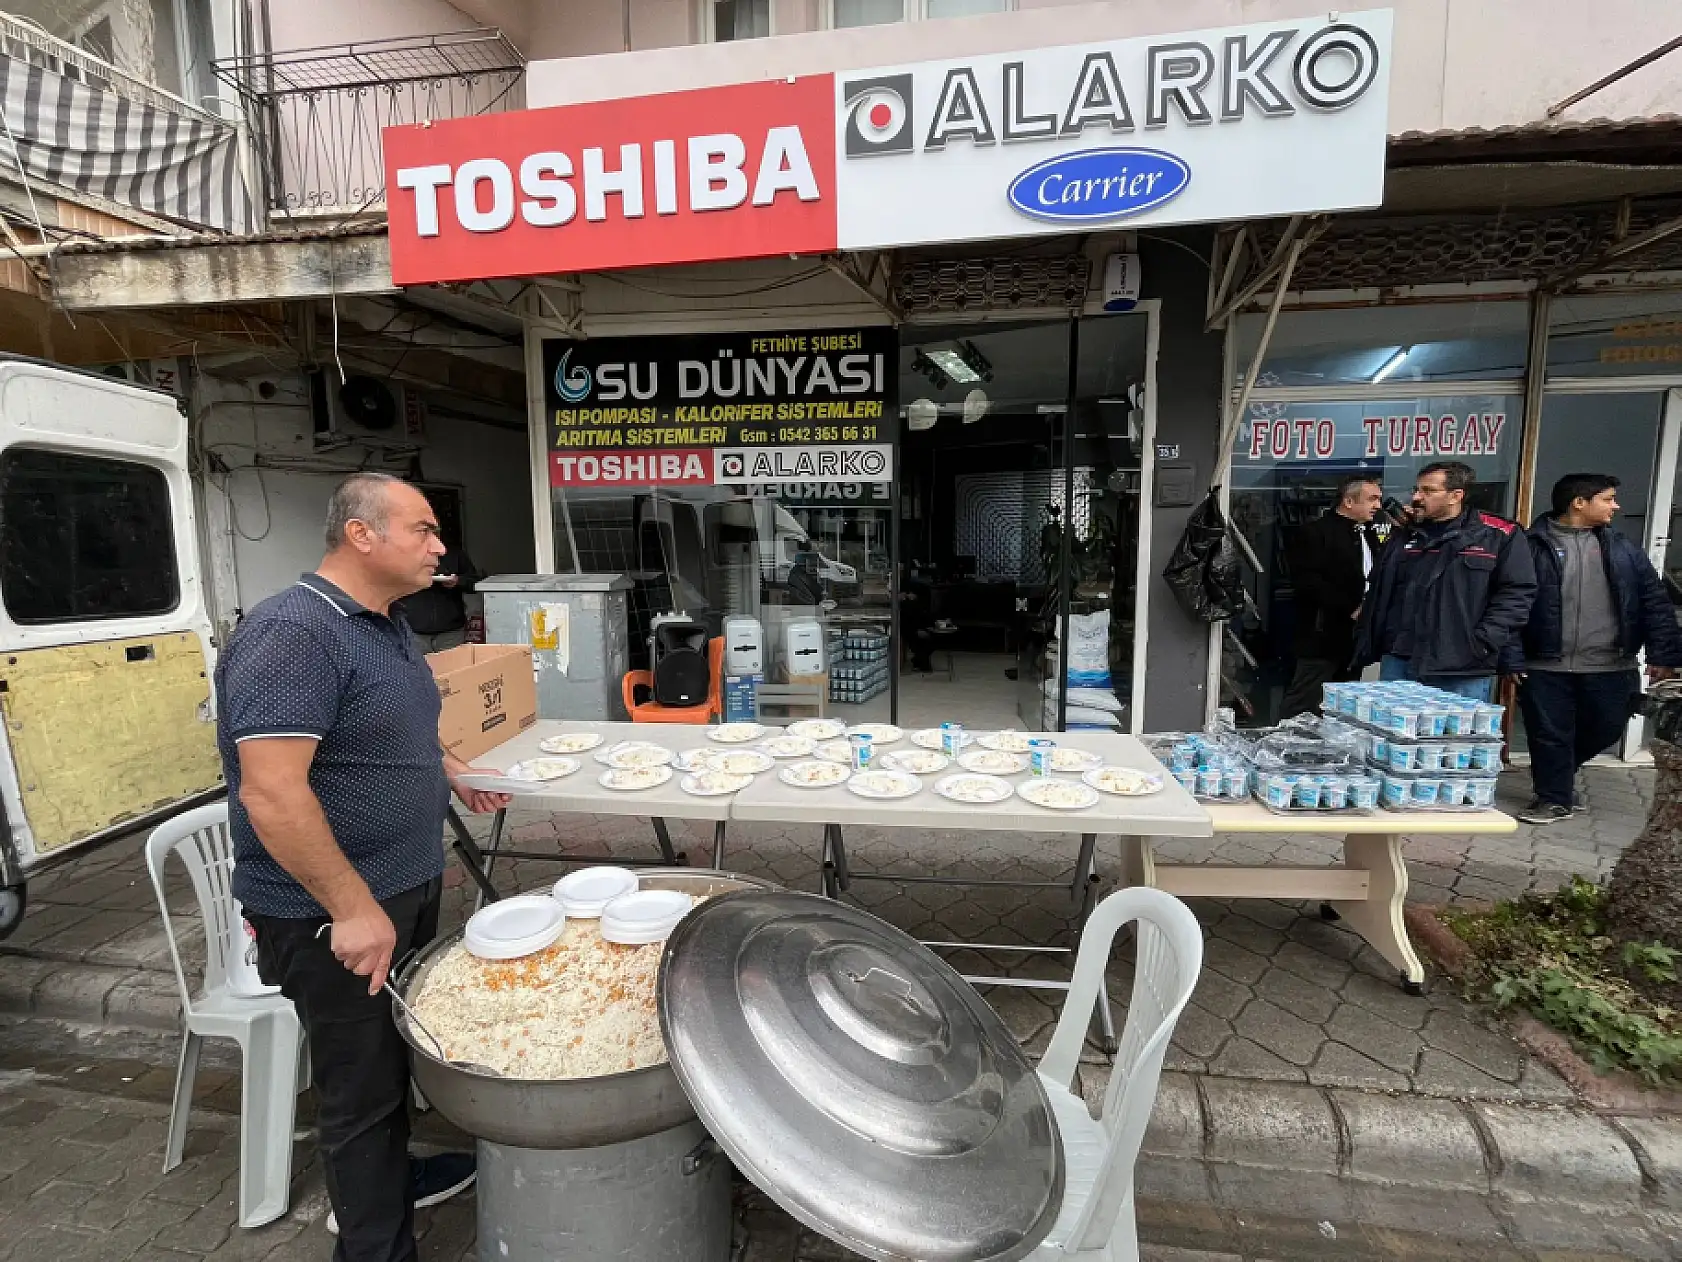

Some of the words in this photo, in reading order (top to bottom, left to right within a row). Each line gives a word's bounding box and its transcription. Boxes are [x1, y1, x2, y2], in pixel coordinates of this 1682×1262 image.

[924, 24, 1379, 152] ALARKO
[397, 125, 820, 237] TOSHIBA
[1037, 167, 1164, 206] Carrier
[752, 335, 806, 353] FETHİYE
[811, 332, 861, 354] ŞUBESİ
[596, 362, 657, 400] SU
[678, 349, 883, 398] DÜNYASI
[555, 409, 577, 426] ISI
[579, 407, 657, 425] POMPASI
[675, 404, 774, 422] KALORİFER
[777, 400, 883, 420] SİSTEMLERİ
[556, 429, 623, 446] ARITMA
[626, 427, 728, 446] SİSTEMLERİ
[740, 429, 768, 442] Gsm
[780, 427, 811, 441] 0542
[814, 426, 838, 440] 365
[862, 425, 877, 440] 31
[1249, 418, 1336, 459] FOTO
[1363, 413, 1506, 456] TURGAY
[557, 454, 705, 481] TOSHIBA
[751, 450, 886, 477] ALARKO
